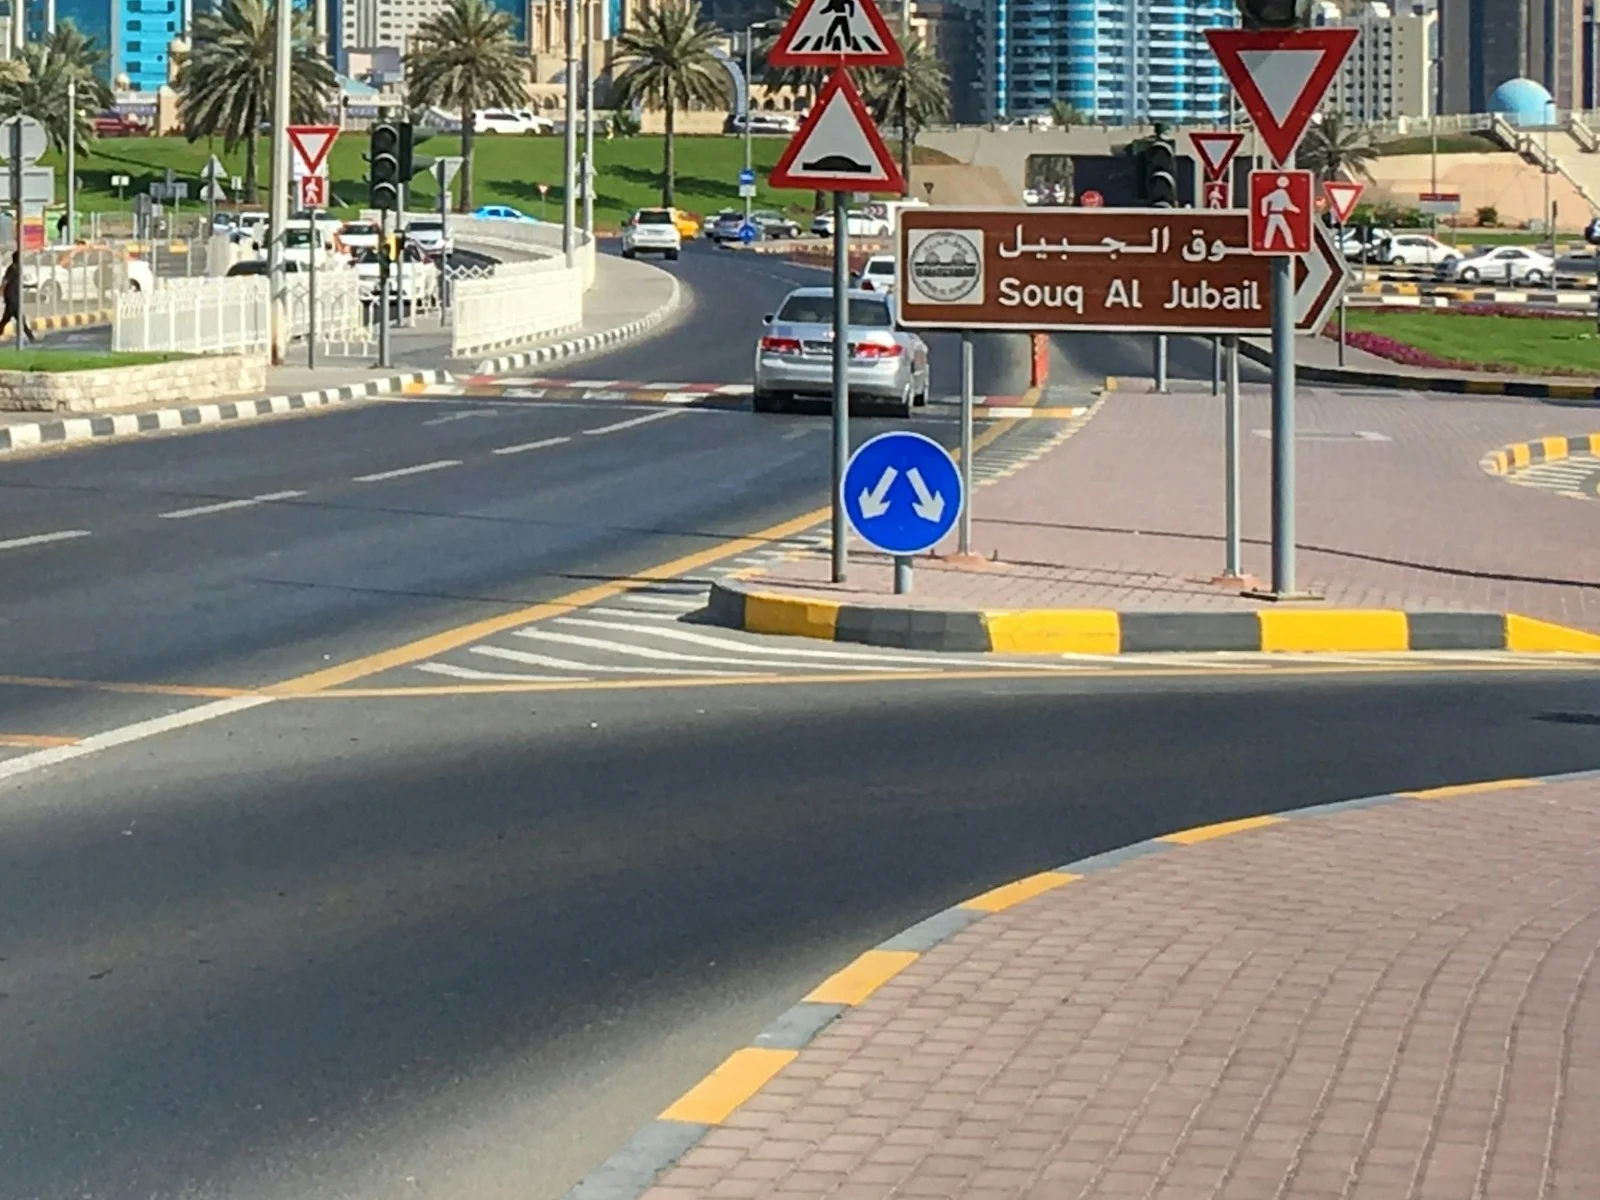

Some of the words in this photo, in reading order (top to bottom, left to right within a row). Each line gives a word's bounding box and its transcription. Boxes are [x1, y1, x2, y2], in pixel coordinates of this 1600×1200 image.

[999, 224, 1170, 261] الجبيل
[1182, 228, 1252, 262] وق
[998, 277, 1084, 314] Souq
[1104, 279, 1143, 309] Al
[1163, 279, 1262, 310] Jubail
